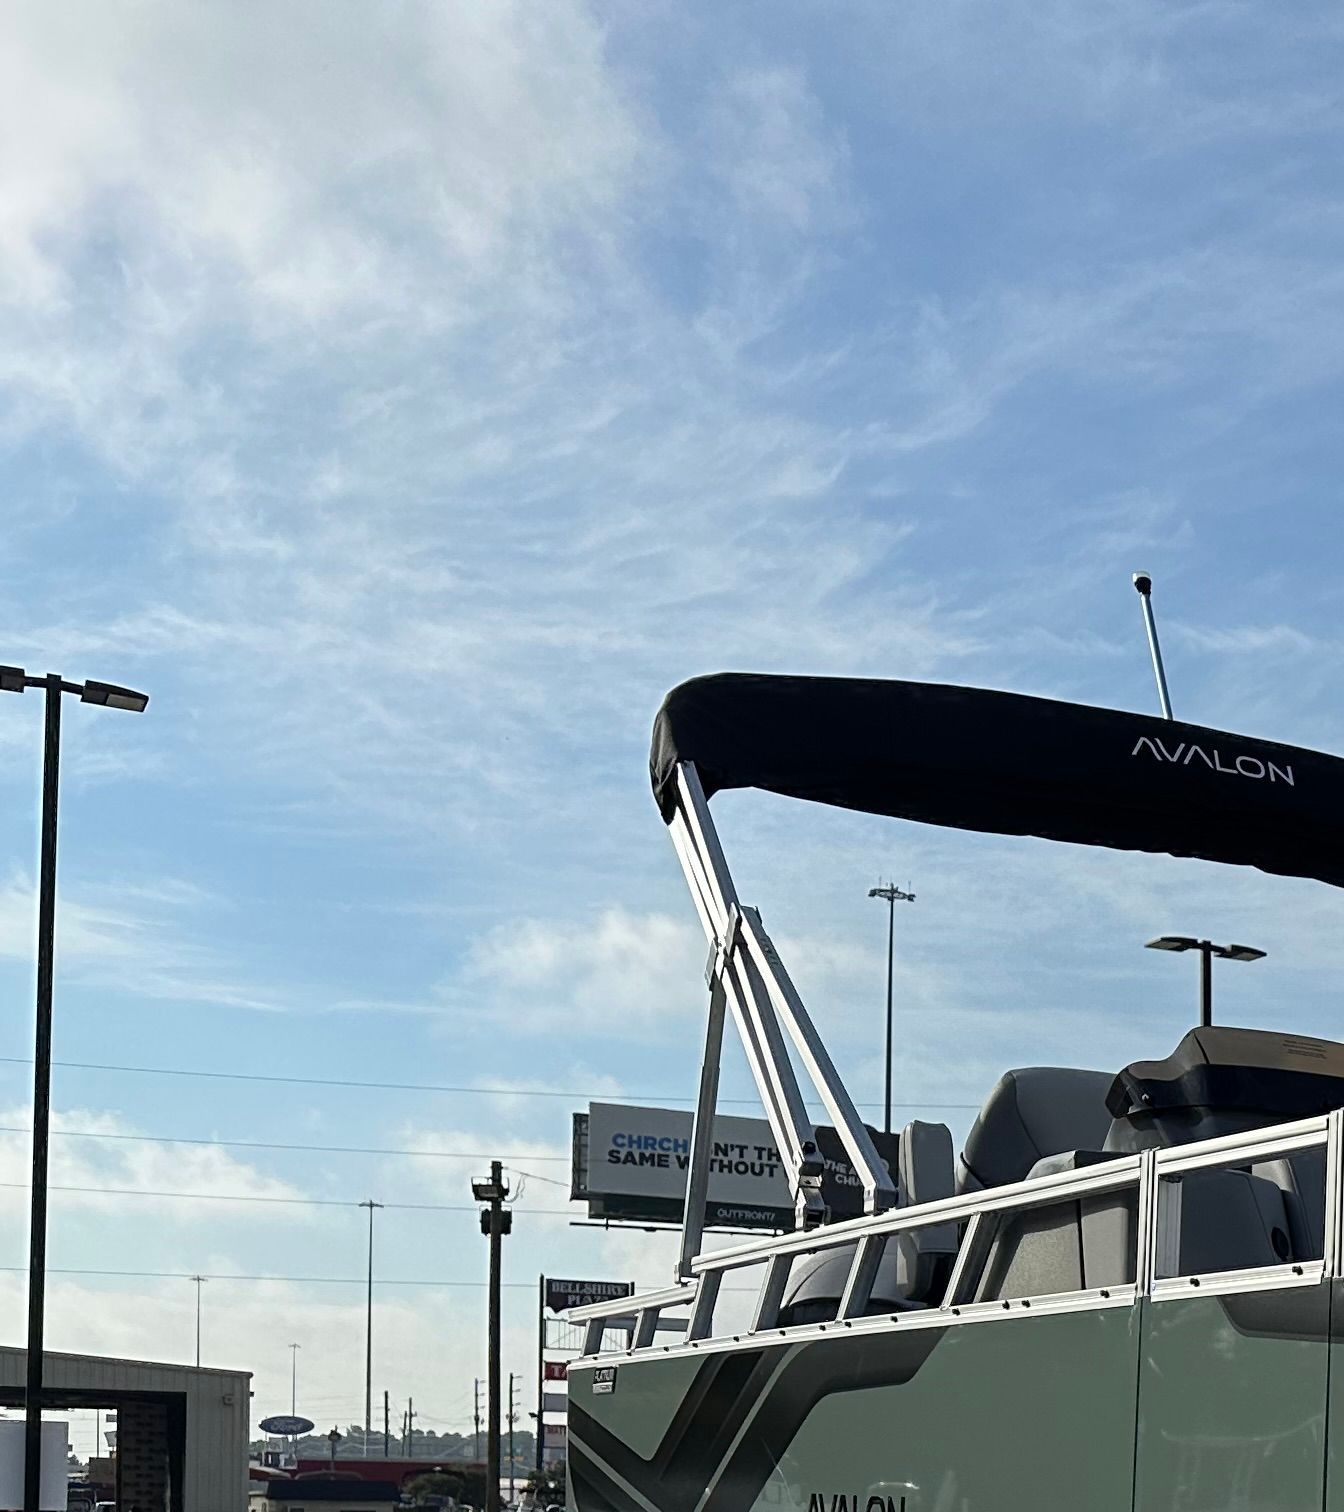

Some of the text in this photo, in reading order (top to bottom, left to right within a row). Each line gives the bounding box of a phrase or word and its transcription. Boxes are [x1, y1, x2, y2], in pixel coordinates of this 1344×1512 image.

[1132, 736, 1295, 786] AVALON
[611, 1133, 689, 1151] CHRCH
[608, 1149, 779, 1178] SAME WTHOUT
